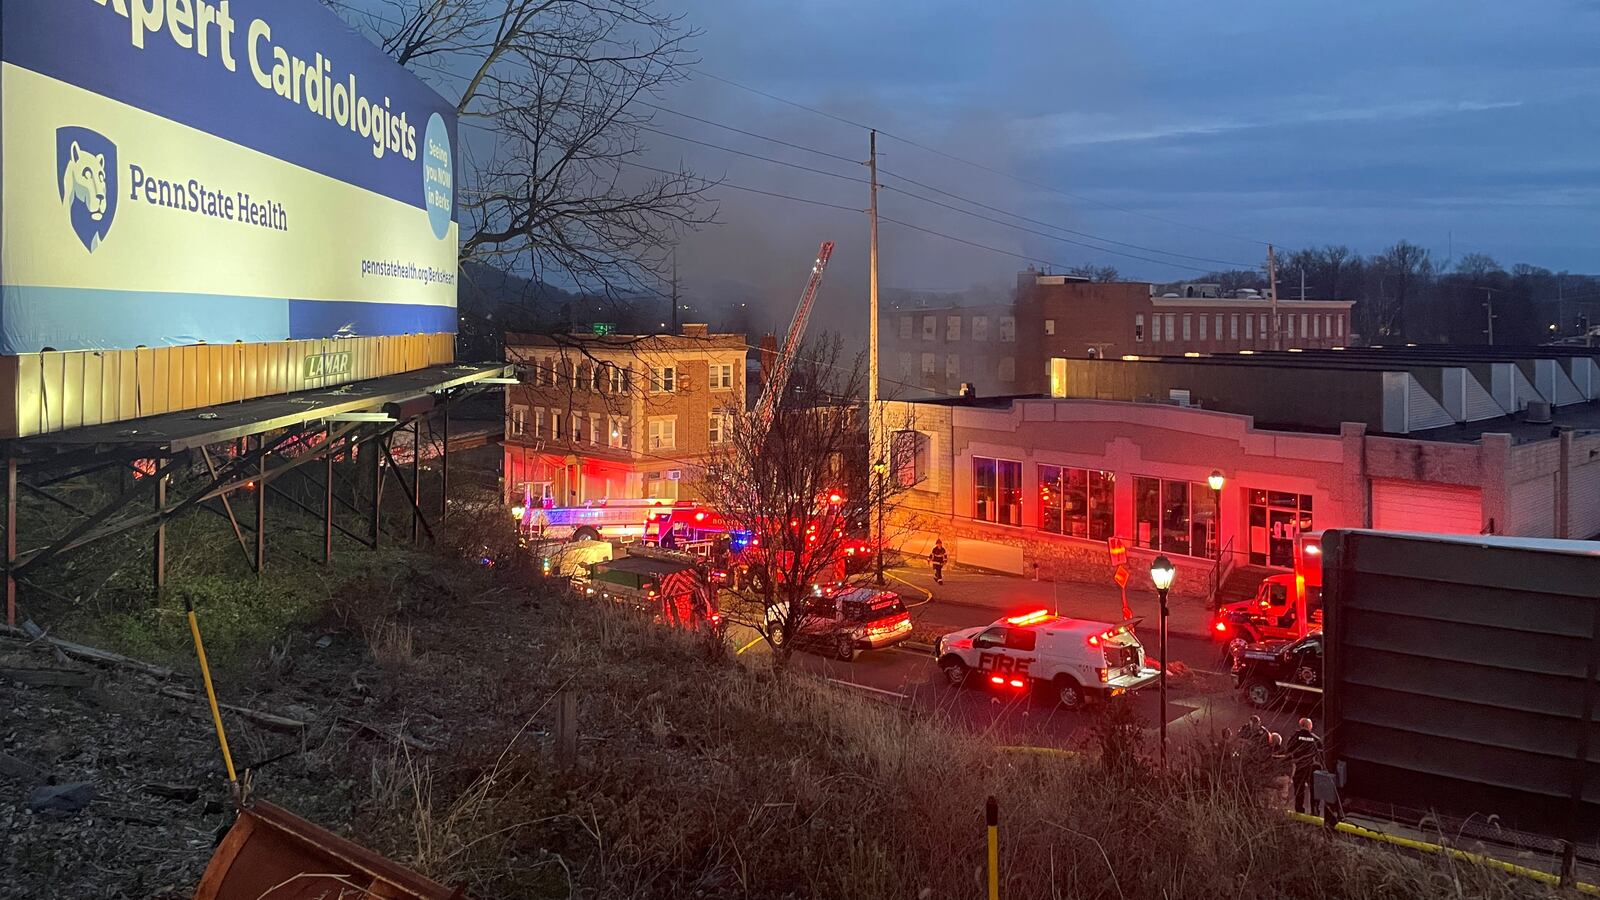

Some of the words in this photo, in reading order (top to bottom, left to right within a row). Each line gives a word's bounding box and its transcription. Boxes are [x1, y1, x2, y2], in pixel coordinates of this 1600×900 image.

[247, 18, 417, 161] Cardiologists
[428, 139, 448, 168] Seeing
[425, 164, 438, 183] you
[437, 166, 451, 189] NOW
[129, 164, 234, 220] PennState
[237, 192, 288, 231] Health
[428, 186, 436, 205] in
[435, 190, 450, 212] Berks
[309, 354, 348, 376] LAMAR
[979, 652, 1035, 676] FIRE
